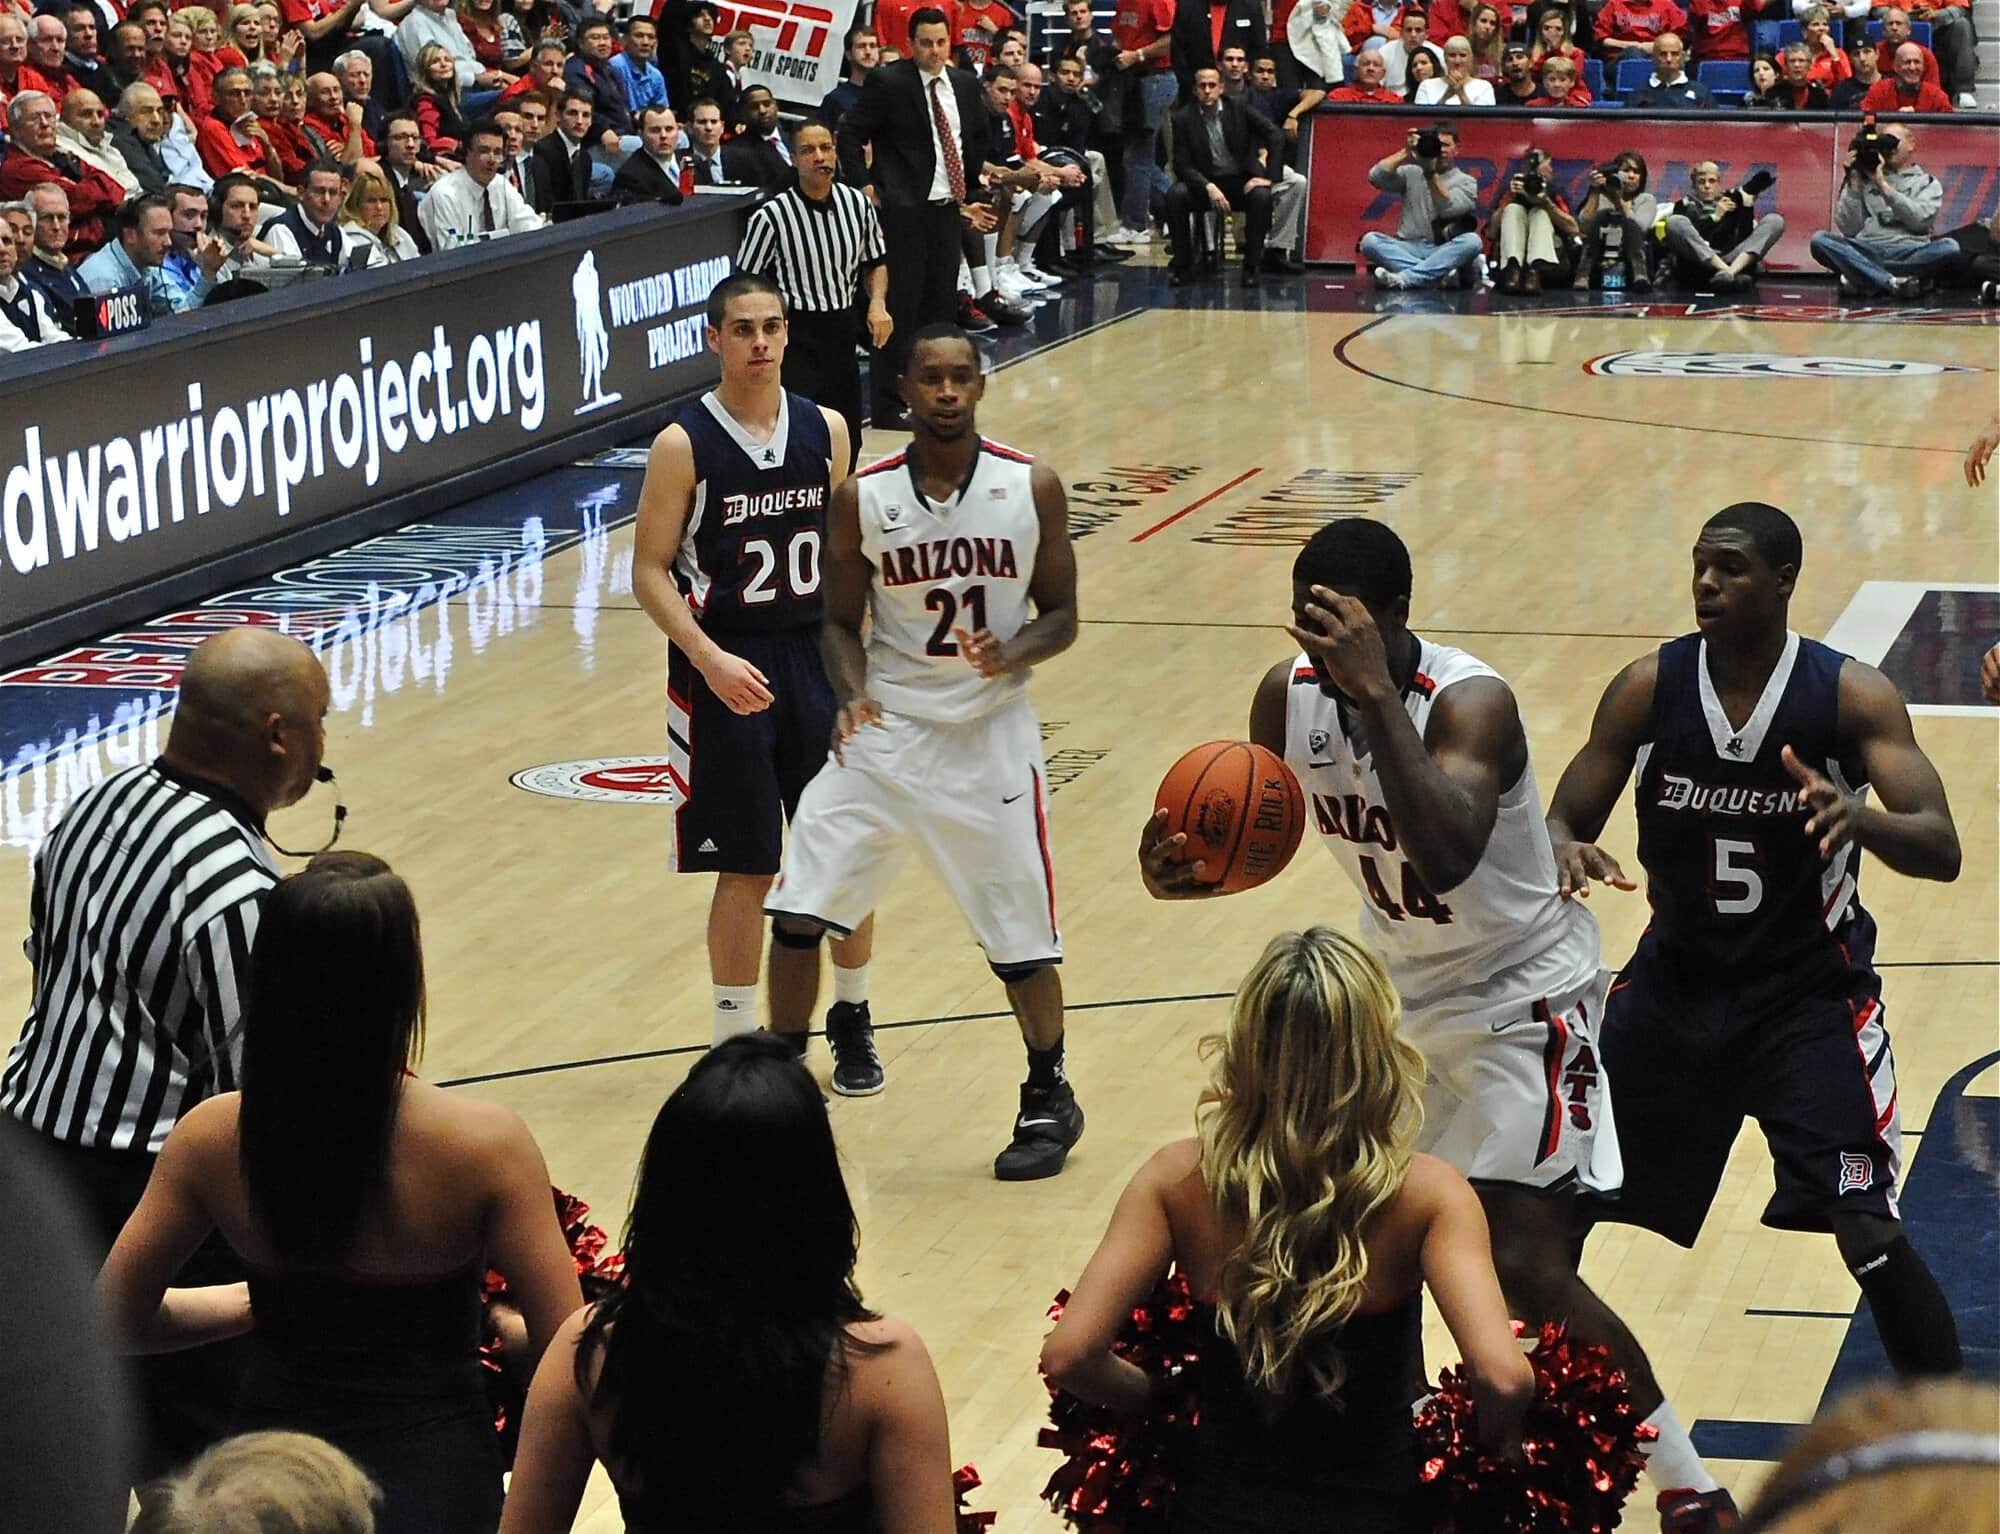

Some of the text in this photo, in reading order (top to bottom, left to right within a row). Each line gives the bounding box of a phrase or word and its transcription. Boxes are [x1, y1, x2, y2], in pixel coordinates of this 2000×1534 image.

[762, 51, 774, 74] IN
[775, 54, 819, 83] SPORTS
[106, 293, 142, 332] POSS.
[608, 271, 674, 329] WOUNDED
[646, 311, 709, 370] PROJECT
[0, 318, 547, 577] dwarriorproject.org
[200, 523, 580, 608] DOWN
[741, 529, 823, 605] 20
[881, 536, 1019, 588] ARIZONA
[924, 584, 987, 658] 21
[1253, 777, 1285, 832] ROCK
[1656, 773, 1809, 816] DUQUESN
[1358, 854, 1454, 925] 44
[1714, 837, 1764, 914] 5
